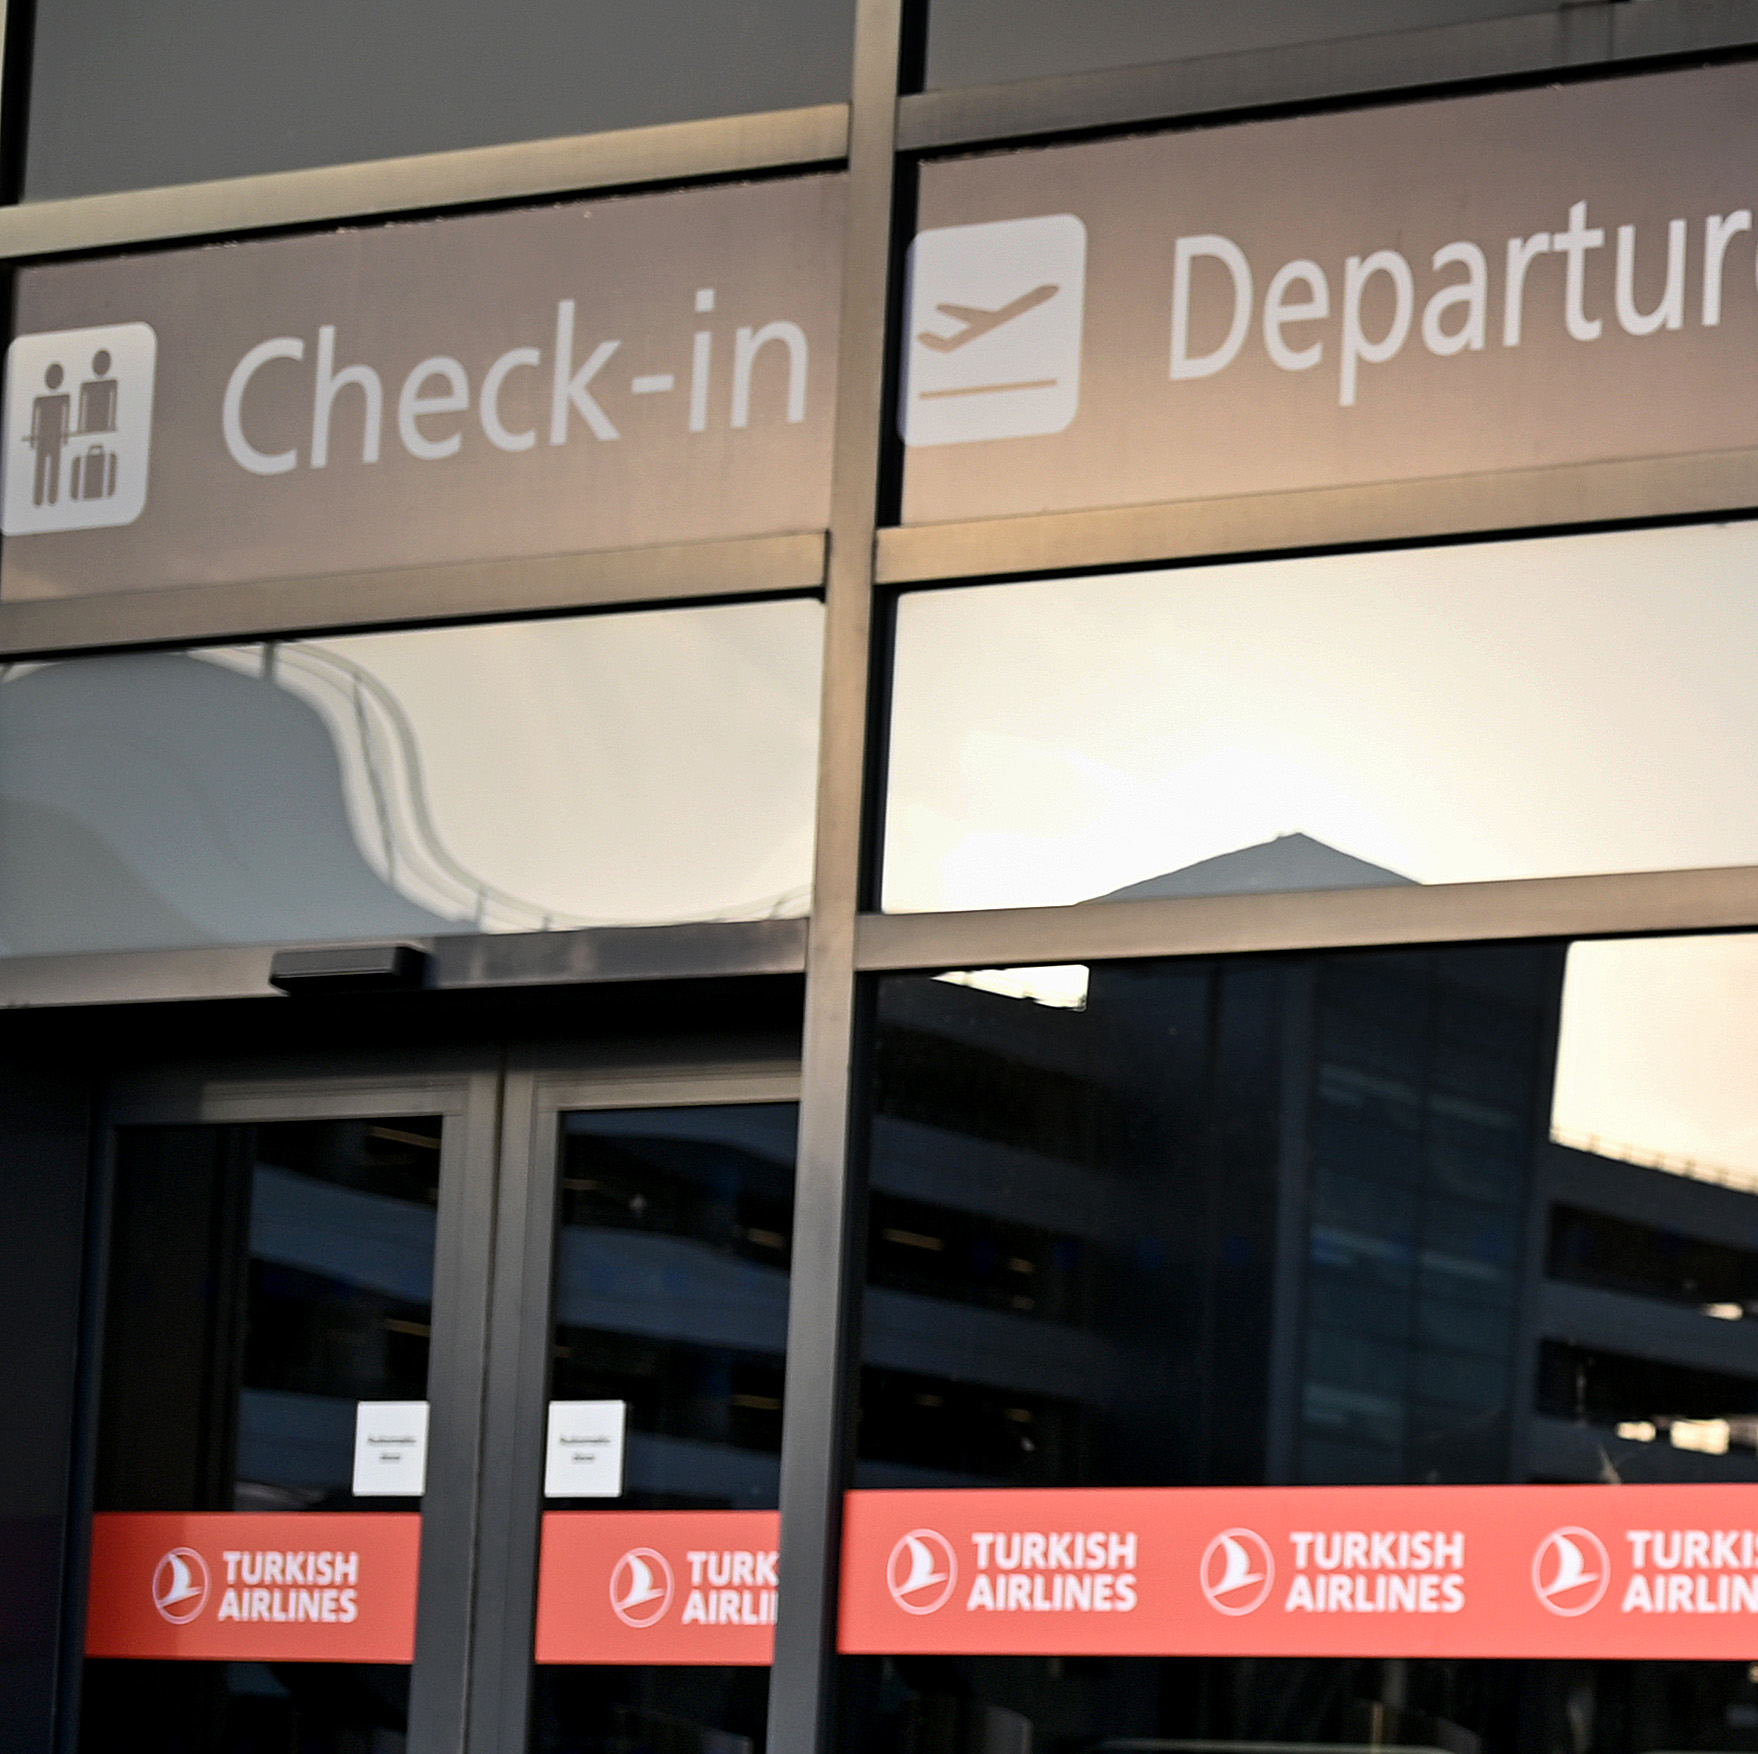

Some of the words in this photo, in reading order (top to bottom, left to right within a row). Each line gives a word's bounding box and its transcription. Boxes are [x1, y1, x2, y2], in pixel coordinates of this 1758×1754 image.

[221, 288, 809, 476] Check-in
[224, 1551, 358, 1585] TURKISH
[687, 1551, 779, 1586] TURK
[972, 1532, 1136, 1569] TURKISH
[1290, 1531, 1464, 1570] TURKISH
[219, 1589, 357, 1623] AIRLINES
[682, 1589, 779, 1625] AIRLI
[967, 1574, 1136, 1612] AIRLINES
[1285, 1574, 1464, 1613] AIRLINES
